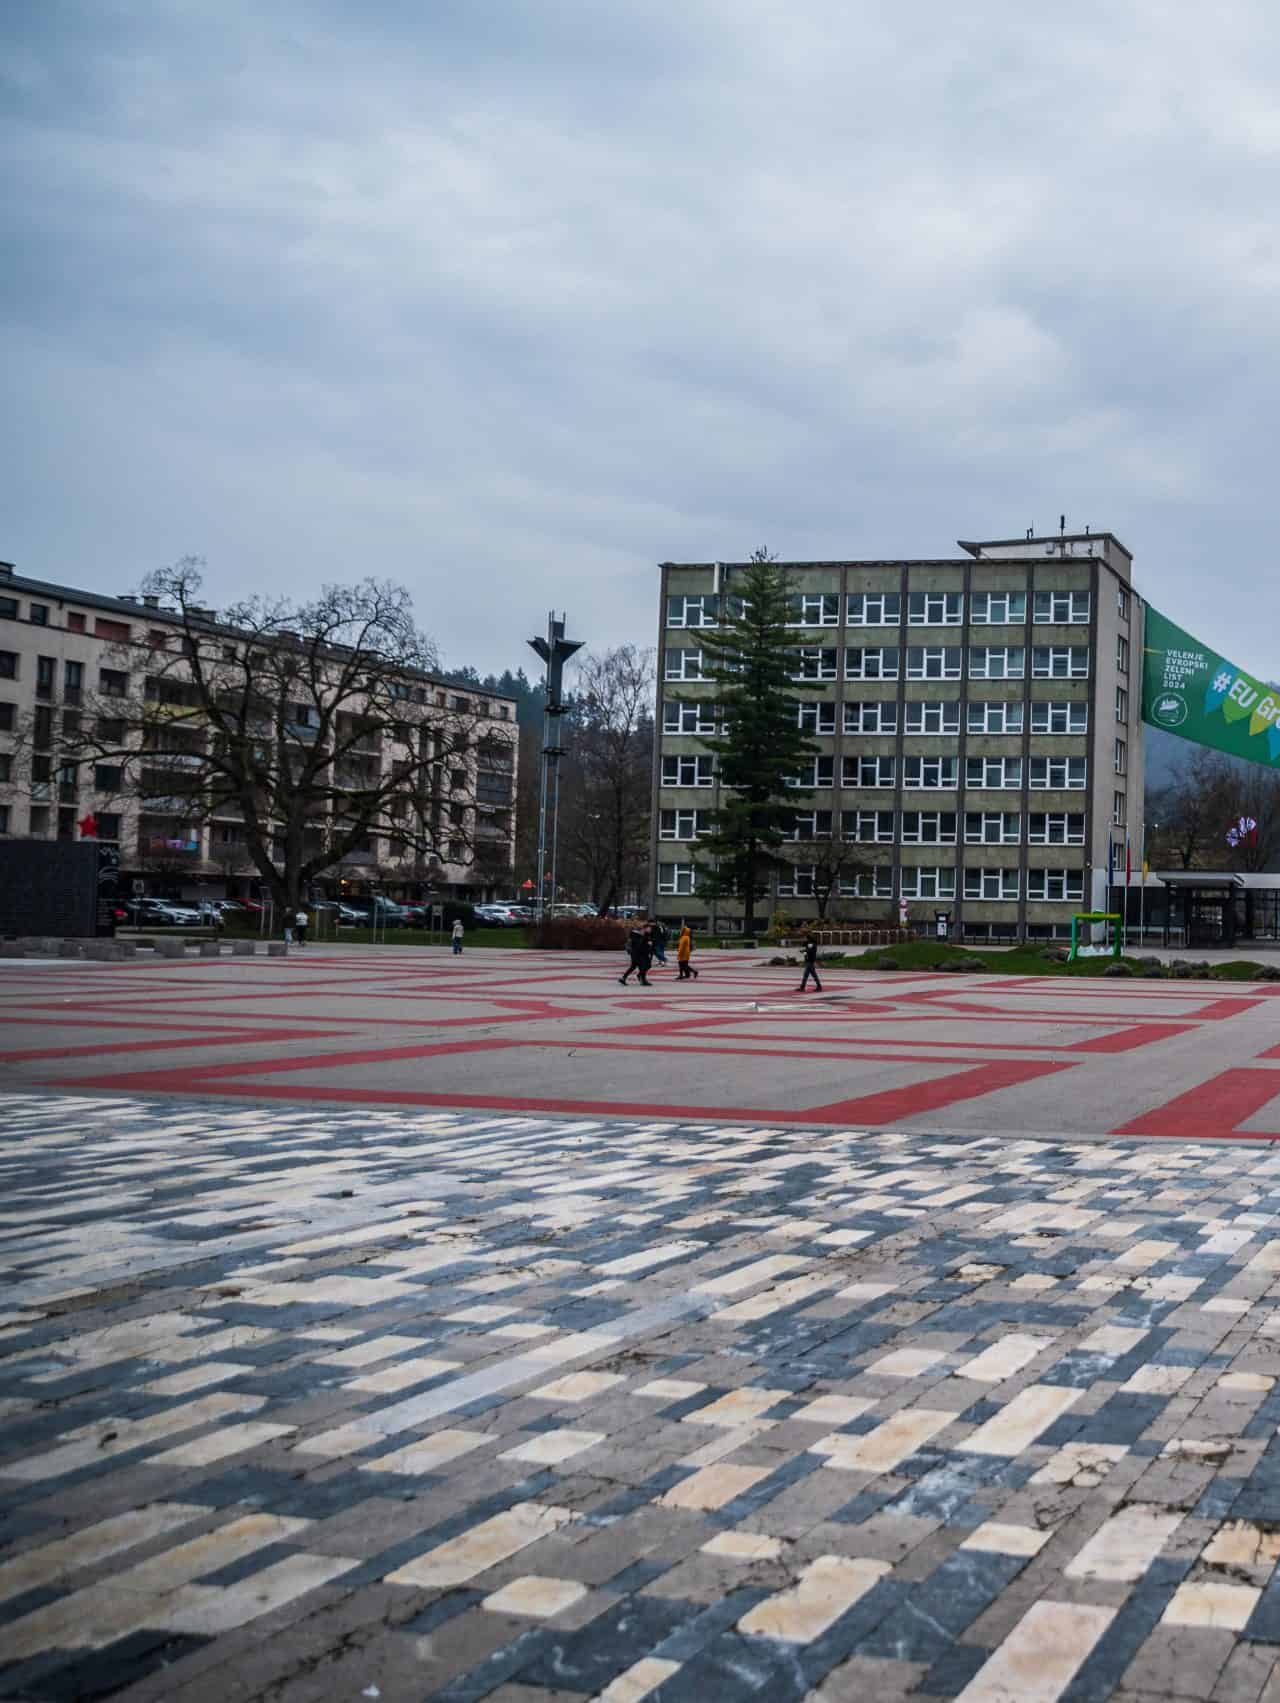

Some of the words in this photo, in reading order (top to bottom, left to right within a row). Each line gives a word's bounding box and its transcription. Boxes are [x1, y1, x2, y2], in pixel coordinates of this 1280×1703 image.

[1167, 649, 1204, 661] VELENJE
[1165, 657, 1208, 670] EVROPSKI
[1164, 665, 1194, 676] ZELENI
[1163, 672, 1182, 681] LIST
[1162, 680, 1185, 689] 2024
